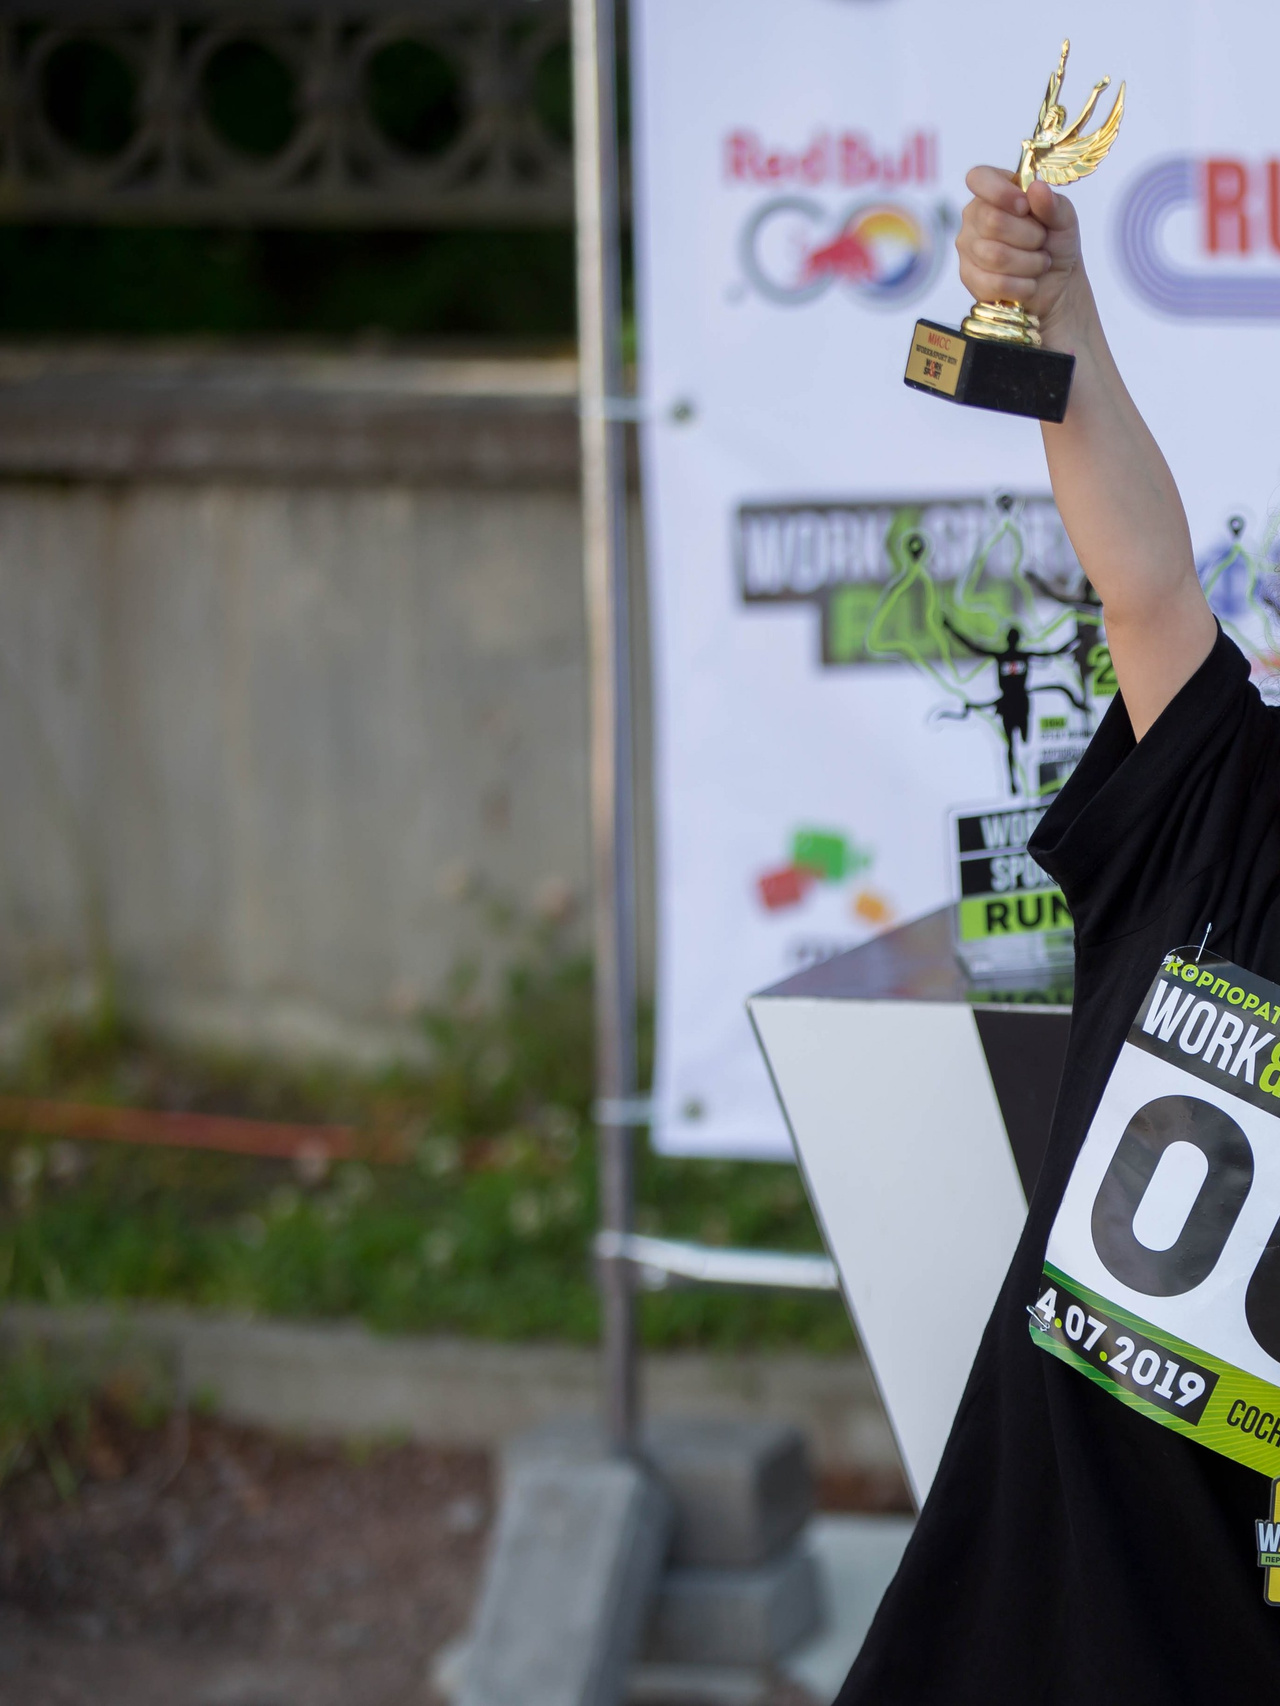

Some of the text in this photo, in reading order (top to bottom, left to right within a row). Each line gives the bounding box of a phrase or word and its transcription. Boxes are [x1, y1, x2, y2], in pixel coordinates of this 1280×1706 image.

[724, 127, 937, 187] Red Bull
[927, 332, 951, 351] МИСС
